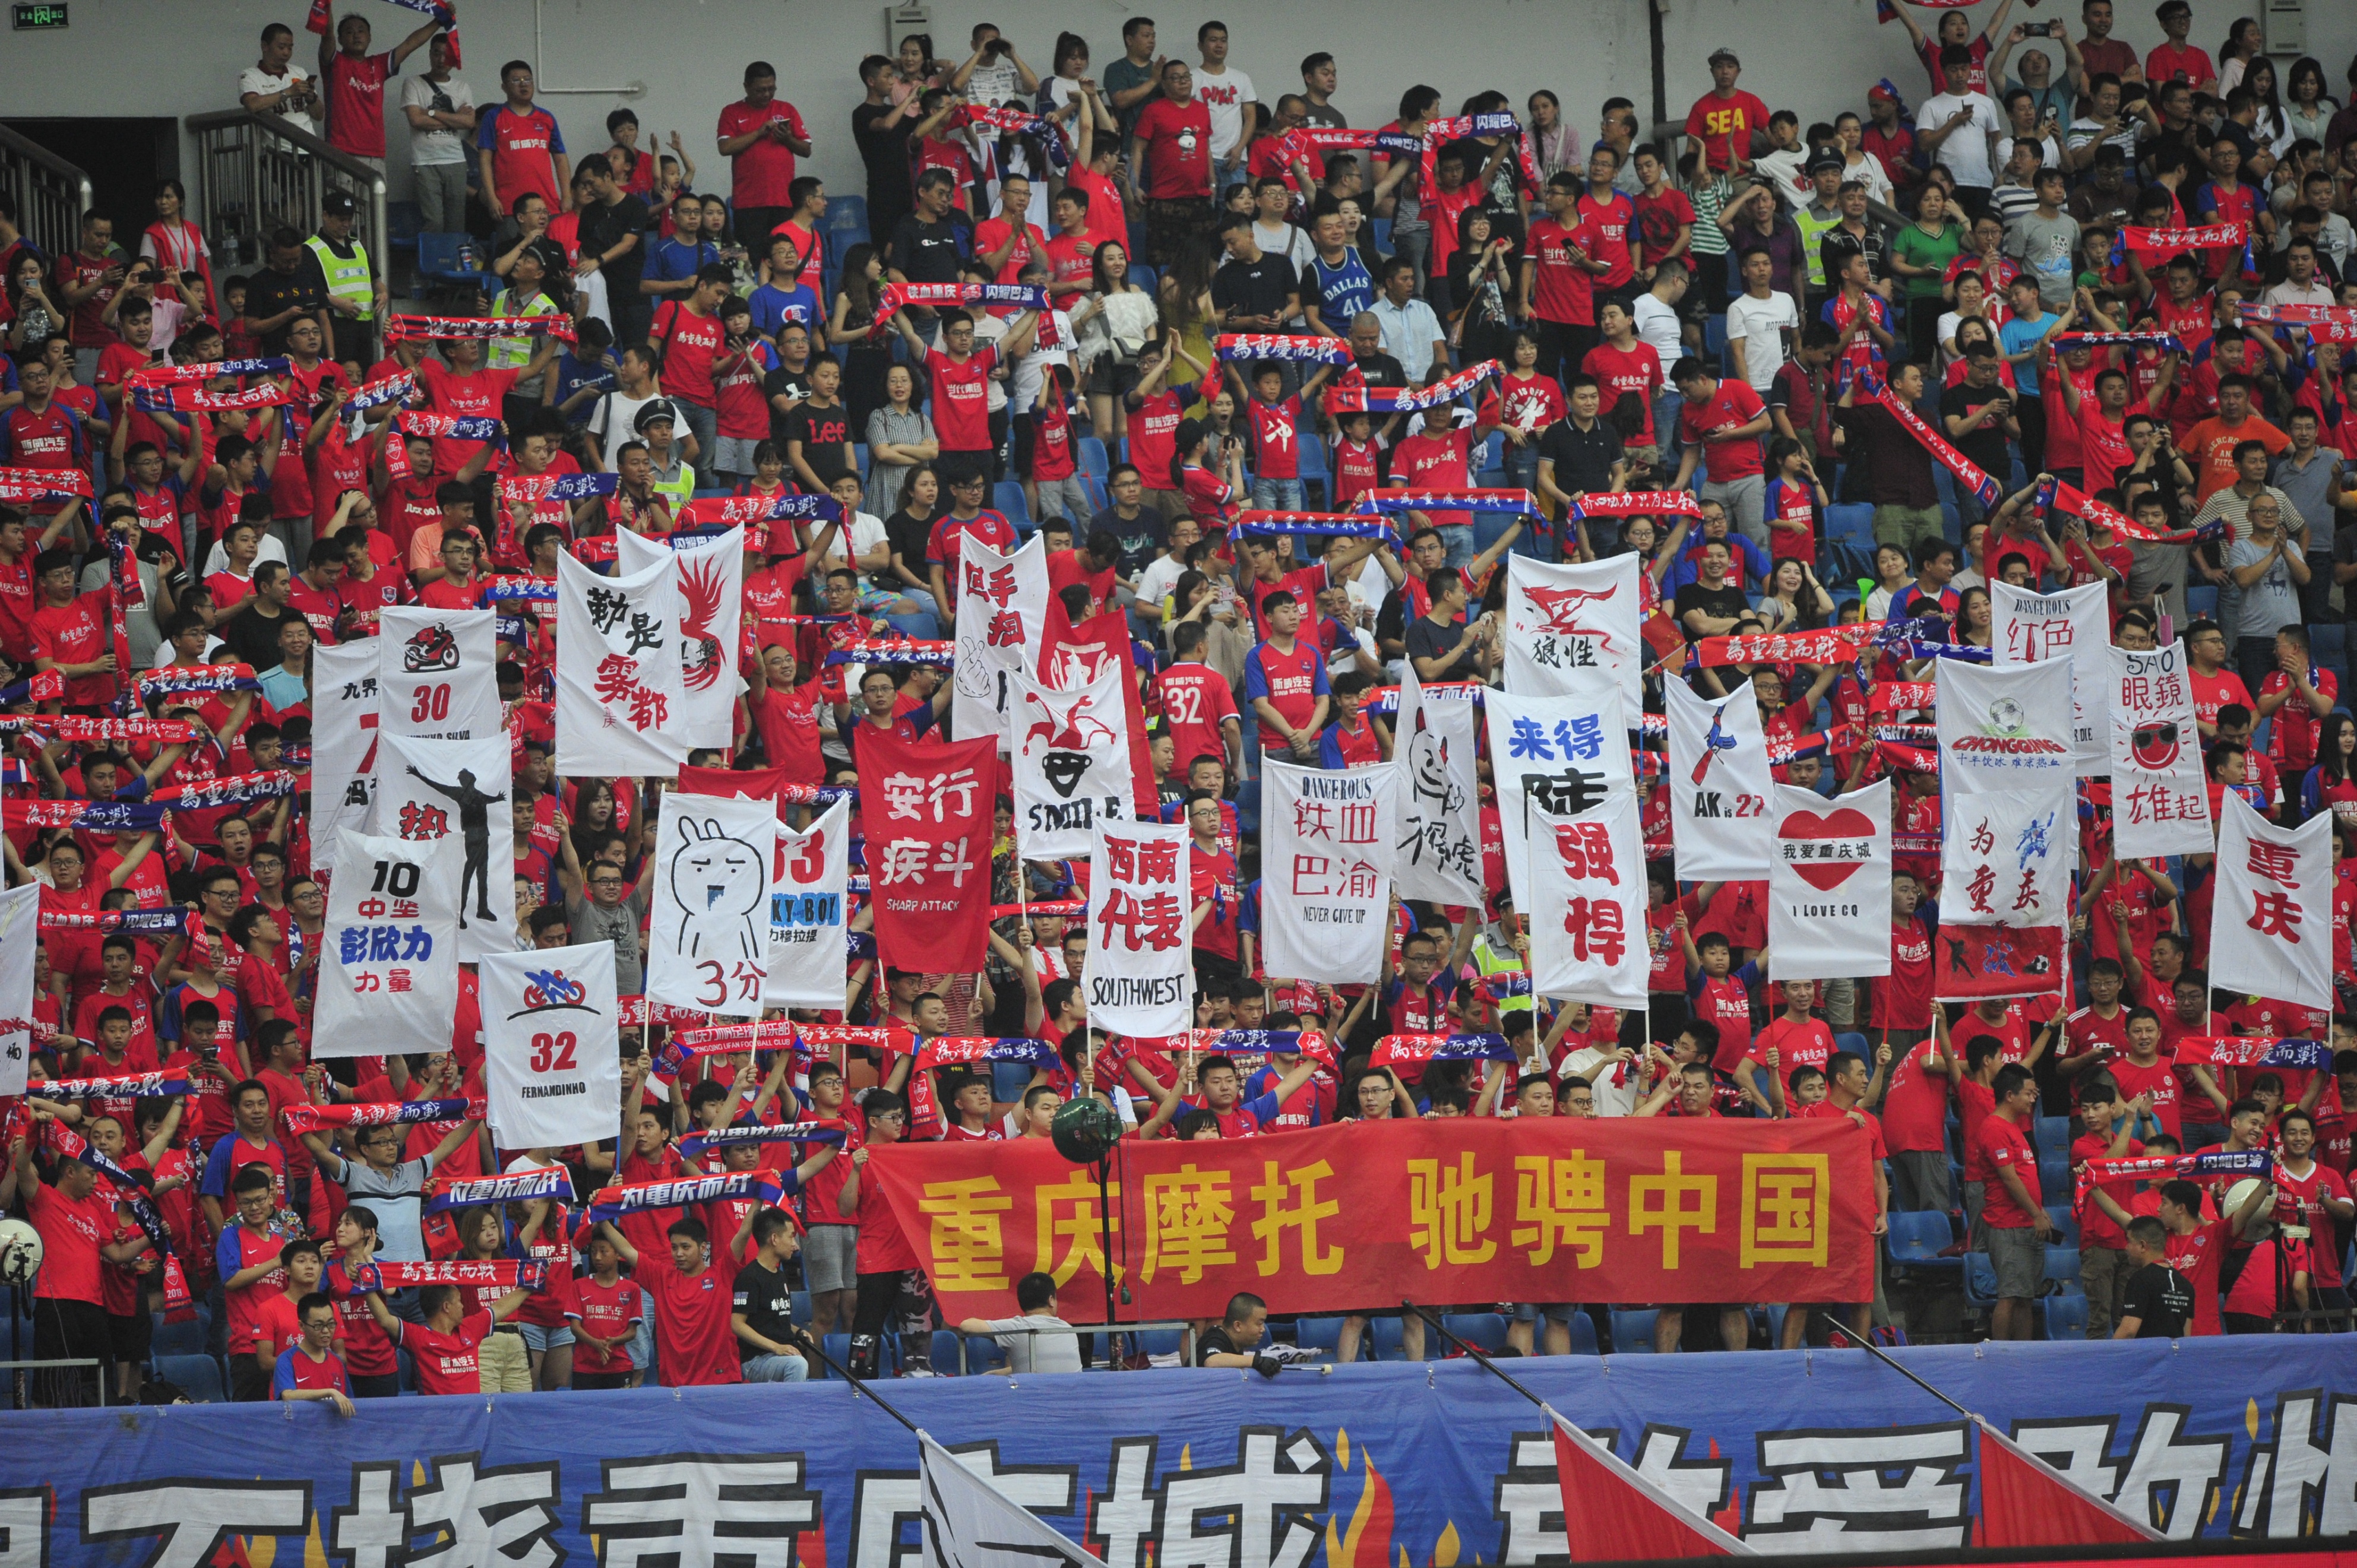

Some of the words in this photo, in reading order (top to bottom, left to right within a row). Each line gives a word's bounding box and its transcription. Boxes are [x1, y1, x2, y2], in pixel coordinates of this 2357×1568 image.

[2189, 75, 2196, 84] 32
[1706, 108, 1745, 137] SEA
[2147, 223, 2239, 247] 為重慶而戰
[907, 285, 957, 299] 铁血重庆
[985, 285, 1034, 300] 闪耀巴渝
[1323, 277, 1369, 300] DALLAS
[1343, 295, 1365, 316] 41
[1232, 335, 1338, 362] 為重慶而戰
[194, 382, 278, 406] 為重慶而戰
[1394, 359, 1496, 411] 為重慶而戰
[1517, 388, 1527, 397] IS
[407, 414, 493, 438] 為重慶而戰
[808, 419, 846, 444] Lee
[1265, 420, 1292, 452] 冲
[21, 436, 67, 450] 斯威汽车
[390, 461, 404, 471] 2019
[505, 478, 597, 501] 為重慶而戰
[1400, 493, 1499, 507] 為重慶而戰
[1583, 493, 1632, 510] 齐心协力
[720, 495, 818, 521] 為重慶而戰
[1263, 514, 1358, 531] 為重慶而戰
[2014, 598, 2071, 616] DANGEROUS
[586, 587, 663, 654] 勒是
[852, 641, 954, 664] 為重慶而戰
[1530, 636, 1599, 669] 狼性
[1726, 634, 1836, 664] 為重慶而戰
[2007, 617, 2074, 664] 红色
[2127, 652, 2174, 675] SAO
[139, 666, 236, 695] 為重慶而戰
[594, 652, 668, 733] 雾都
[1165, 676, 1204, 685] 斯威汽车
[1273, 676, 1311, 690] 斯威汽车
[2122, 672, 2184, 712] 眼鏡
[411, 683, 451, 723] 30
[1167, 687, 1204, 724] 32
[53, 720, 77, 728] FIGHT
[161, 723, 184, 733] CHONG
[602, 706, 618, 730] 重庆
[1508, 713, 1605, 762] 来得
[1874, 726, 1912, 740] FIGHT
[1951, 737, 2067, 754] CHONGQING
[1956, 753, 2007, 769] 十年饮冰
[2010, 755, 2061, 769] 难凉热血
[179, 772, 293, 809] 為重慶而戰
[882, 768, 979, 823] 安行
[1302, 777, 1372, 800] DANGEROUS
[26, 803, 132, 826] 為重慶而戰
[1694, 792, 1722, 818] AK
[1724, 806, 1732, 818] is
[1735, 793, 1765, 818] 27
[2125, 783, 2207, 825] 雄起
[400, 800, 451, 840] 热
[1293, 799, 1378, 844] 铁血
[1969, 815, 1995, 856] 为
[881, 837, 974, 888] 疾斗
[1104, 834, 1180, 885] 西南
[1552, 822, 1621, 887] 强
[1783, 842, 1871, 861] 我爱重庆城
[2247, 835, 2301, 891] 重
[371, 860, 420, 898] 10
[1292, 853, 1379, 899] 巴渝
[1965, 865, 2040, 916] 重庆
[358, 897, 420, 920] 中坚
[772, 898, 792, 923] KY
[805, 896, 836, 920] BOY
[887, 899, 919, 911] SHARP
[920, 899, 960, 911] ATTACK
[1304, 905, 1329, 923] NEVER
[1332, 907, 1352, 924] GIVE
[1355, 910, 1366, 925] UP
[1793, 905, 1796, 917] I
[1803, 904, 1836, 917] LOVE
[1842, 904, 1858, 917] CQ
[2247, 889, 2304, 945] 庆
[41, 911, 95, 929] 铁血重庆
[124, 913, 176, 929] 闪耀巴渝
[1097, 888, 1183, 952] 代表
[1564, 897, 1625, 967] 悍
[340, 926, 432, 965] 彭欣力
[355, 969, 413, 993] 力量
[695, 959, 767, 1008] 3分
[1090, 973, 1185, 1007] SOUTHWEST
[1716, 998, 1749, 1012] 斯威汽车
[723, 1041, 739, 1051] LIFAN
[936, 1038, 1038, 1062] 為重慶而戰
[1166, 1029, 1270, 1047] 為重慶而戰
[1389, 1034, 1488, 1059] 為重慶而戰
[530, 1031, 577, 1073] 32
[1103, 1056, 1118, 1070] 2019
[2210, 1038, 2318, 1066] 為重慶而戰
[521, 1082, 586, 1098] FERNANDINHO
[350, 1100, 442, 1124] 為重慶而戰
[914, 1105, 929, 1113] 2019
[2318, 1105, 2334, 1116] 2019
[2106, 1155, 2166, 1176] 铁血重庆
[2202, 1153, 2263, 1170] 闪耀巴渝
[448, 1170, 562, 1204] 为重庆而战
[620, 1173, 752, 1211] 为重庆而战
[1406, 1148, 1830, 1271] 驰骋中国
[918, 1164, 1345, 1293] 重庆摩托
[401, 1262, 496, 1282] 為重慶而戰
[166, 1288, 182, 1298] 2019
[441, 1354, 475, 1369] 斯威汽车
